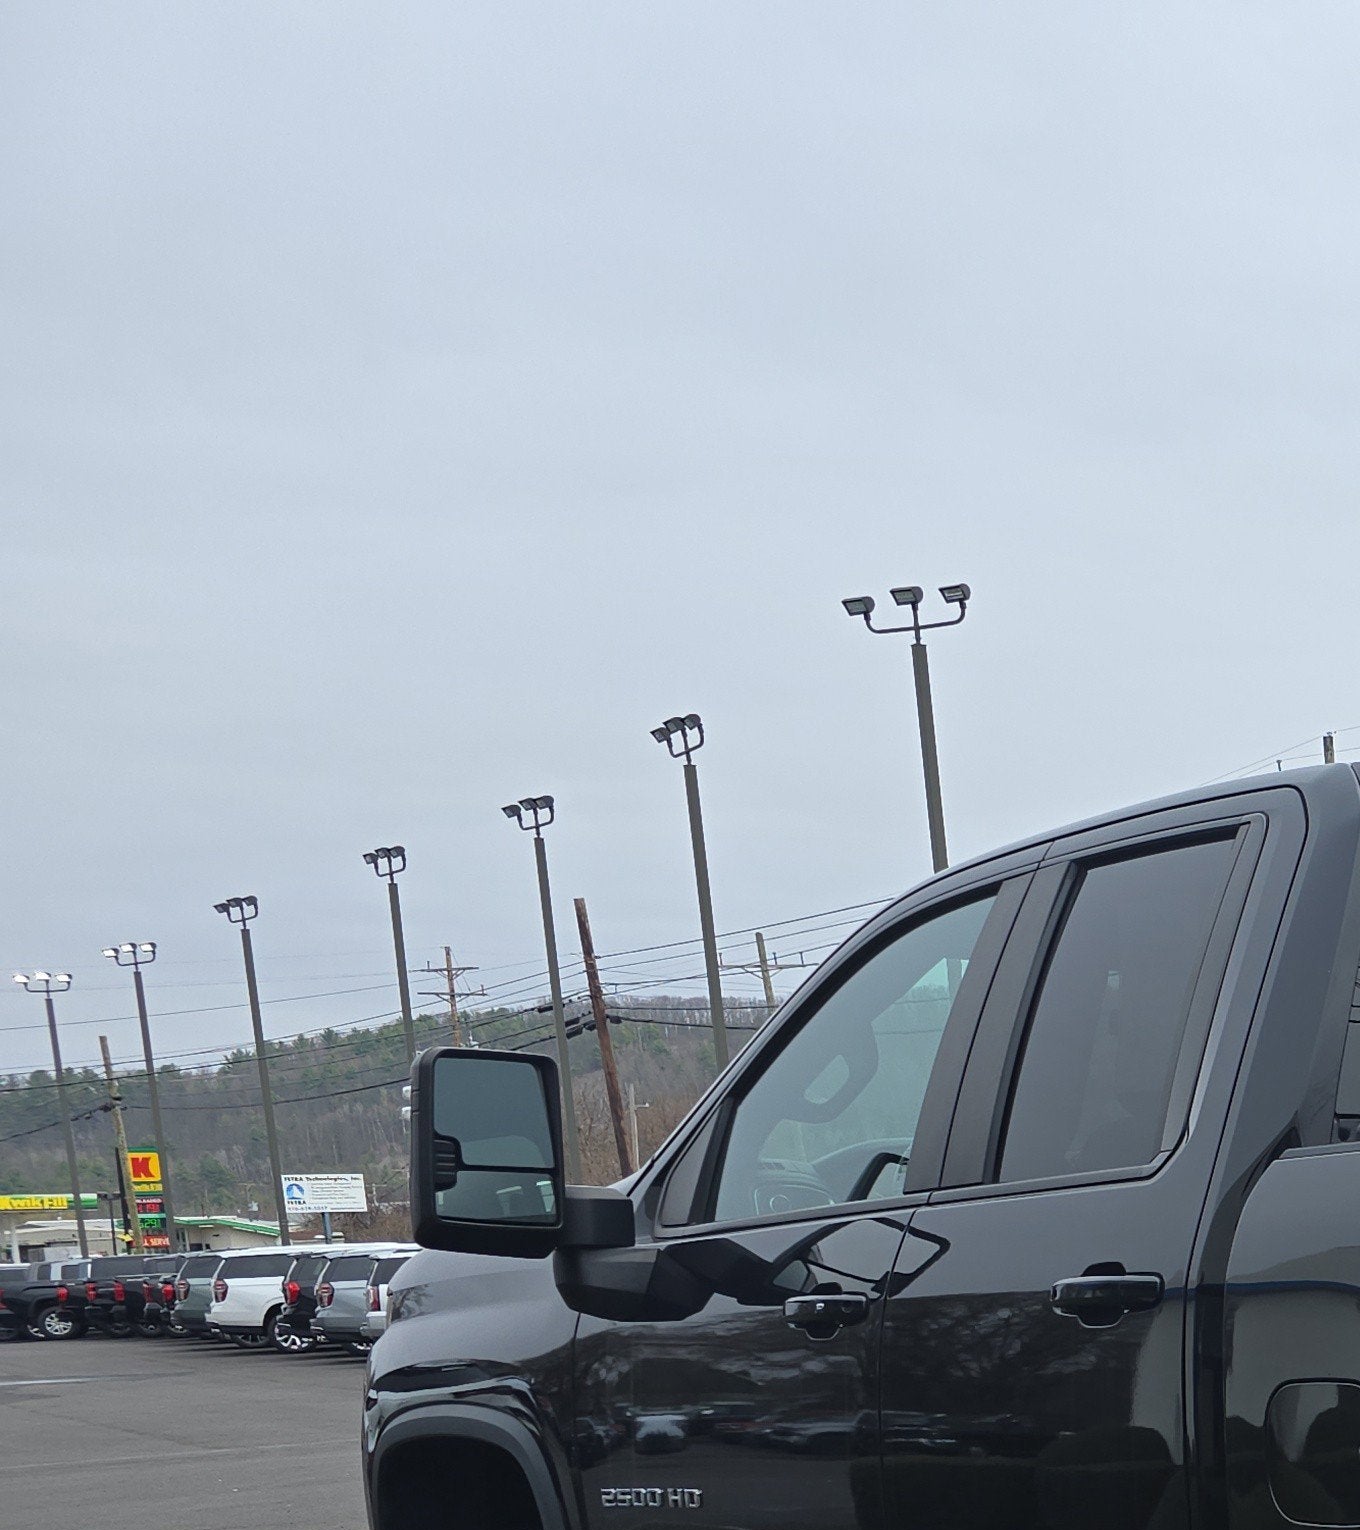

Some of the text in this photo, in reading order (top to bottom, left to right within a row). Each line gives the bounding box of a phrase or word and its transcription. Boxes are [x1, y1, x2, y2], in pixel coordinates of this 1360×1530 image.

[130, 1156, 155, 1178] K
[600, 1487, 703, 1508] 2500 HD
